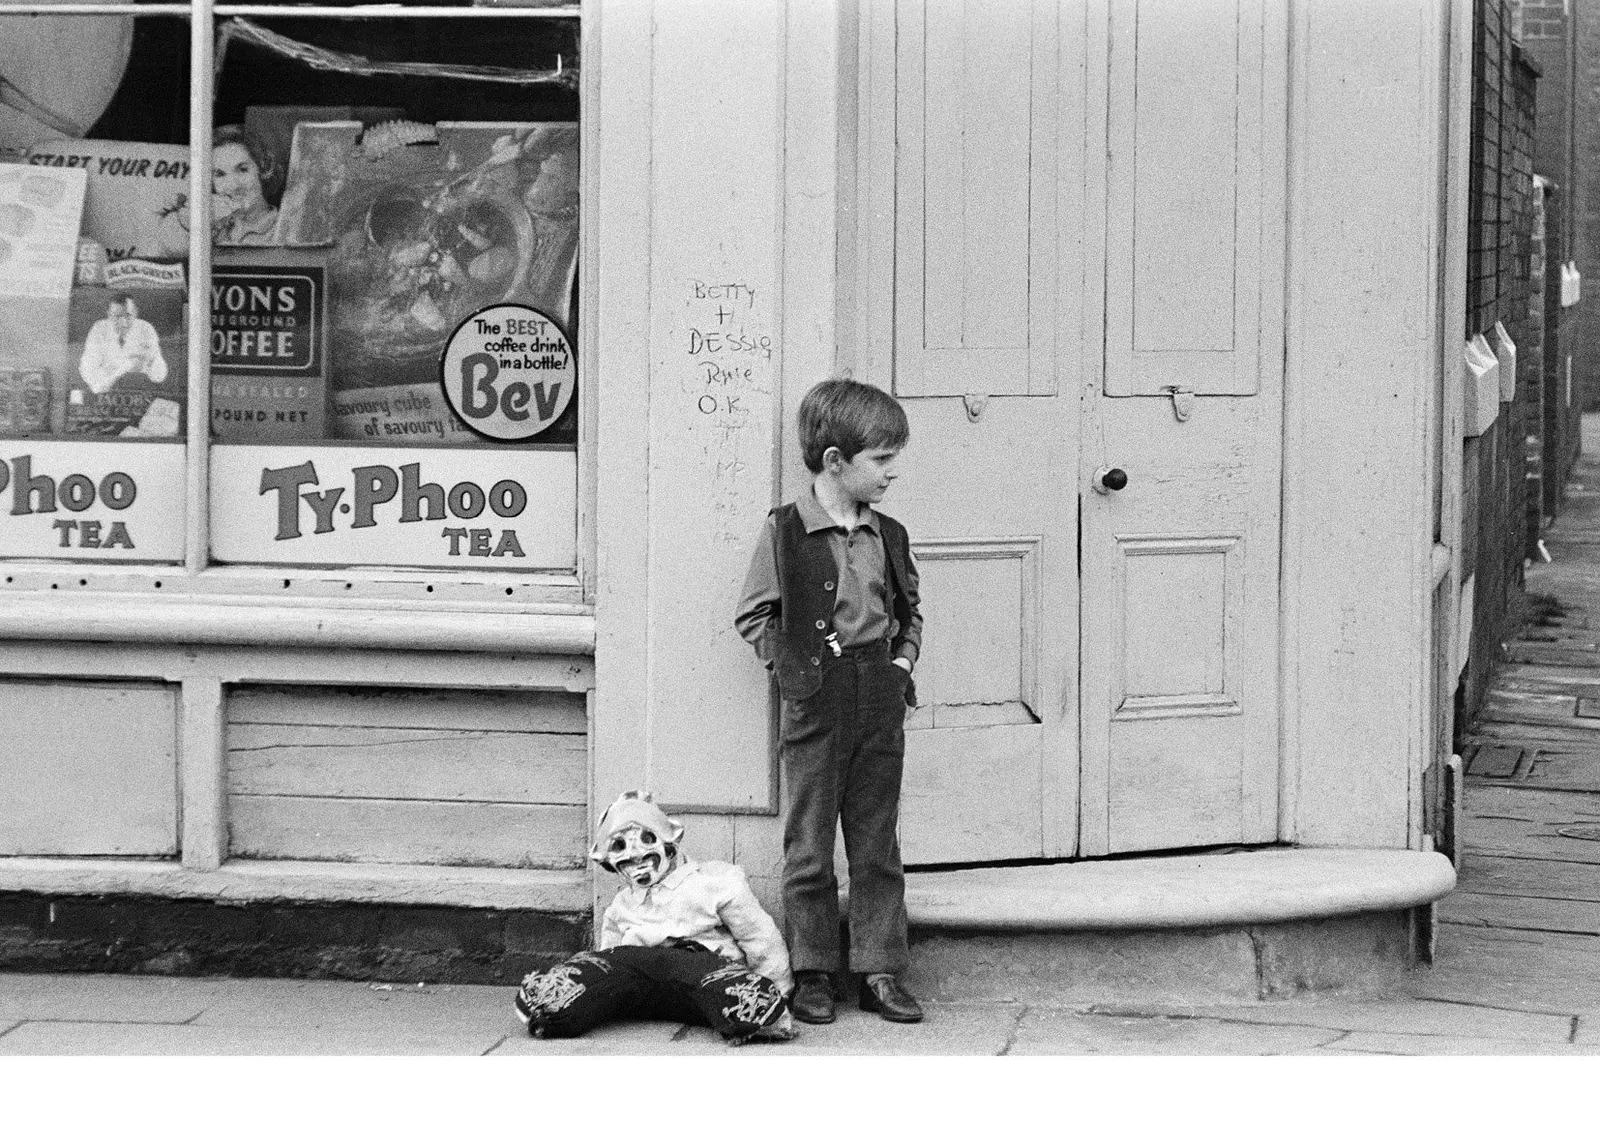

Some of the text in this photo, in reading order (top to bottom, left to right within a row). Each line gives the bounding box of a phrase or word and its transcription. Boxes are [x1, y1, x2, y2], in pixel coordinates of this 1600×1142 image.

[98, 157, 151, 178] YOUR
[153, 160, 190, 179] DAY
[211, 285, 296, 312] YONS
[229, 315, 296, 327] GROUND
[474, 319, 548, 336] The BEST
[211, 330, 295, 358] OFFEE
[484, 338, 567, 354] coffee drink
[500, 354, 569, 370] in a bottle!
[460, 352, 562, 422] Bev
[214, 408, 308, 423] POUND NET
[364, 417, 380, 436] of
[385, 418, 445, 437] savoury
[0, 455, 137, 516] hoo
[52, 519, 135, 549] TEA
[441, 527, 526, 557] TEA
